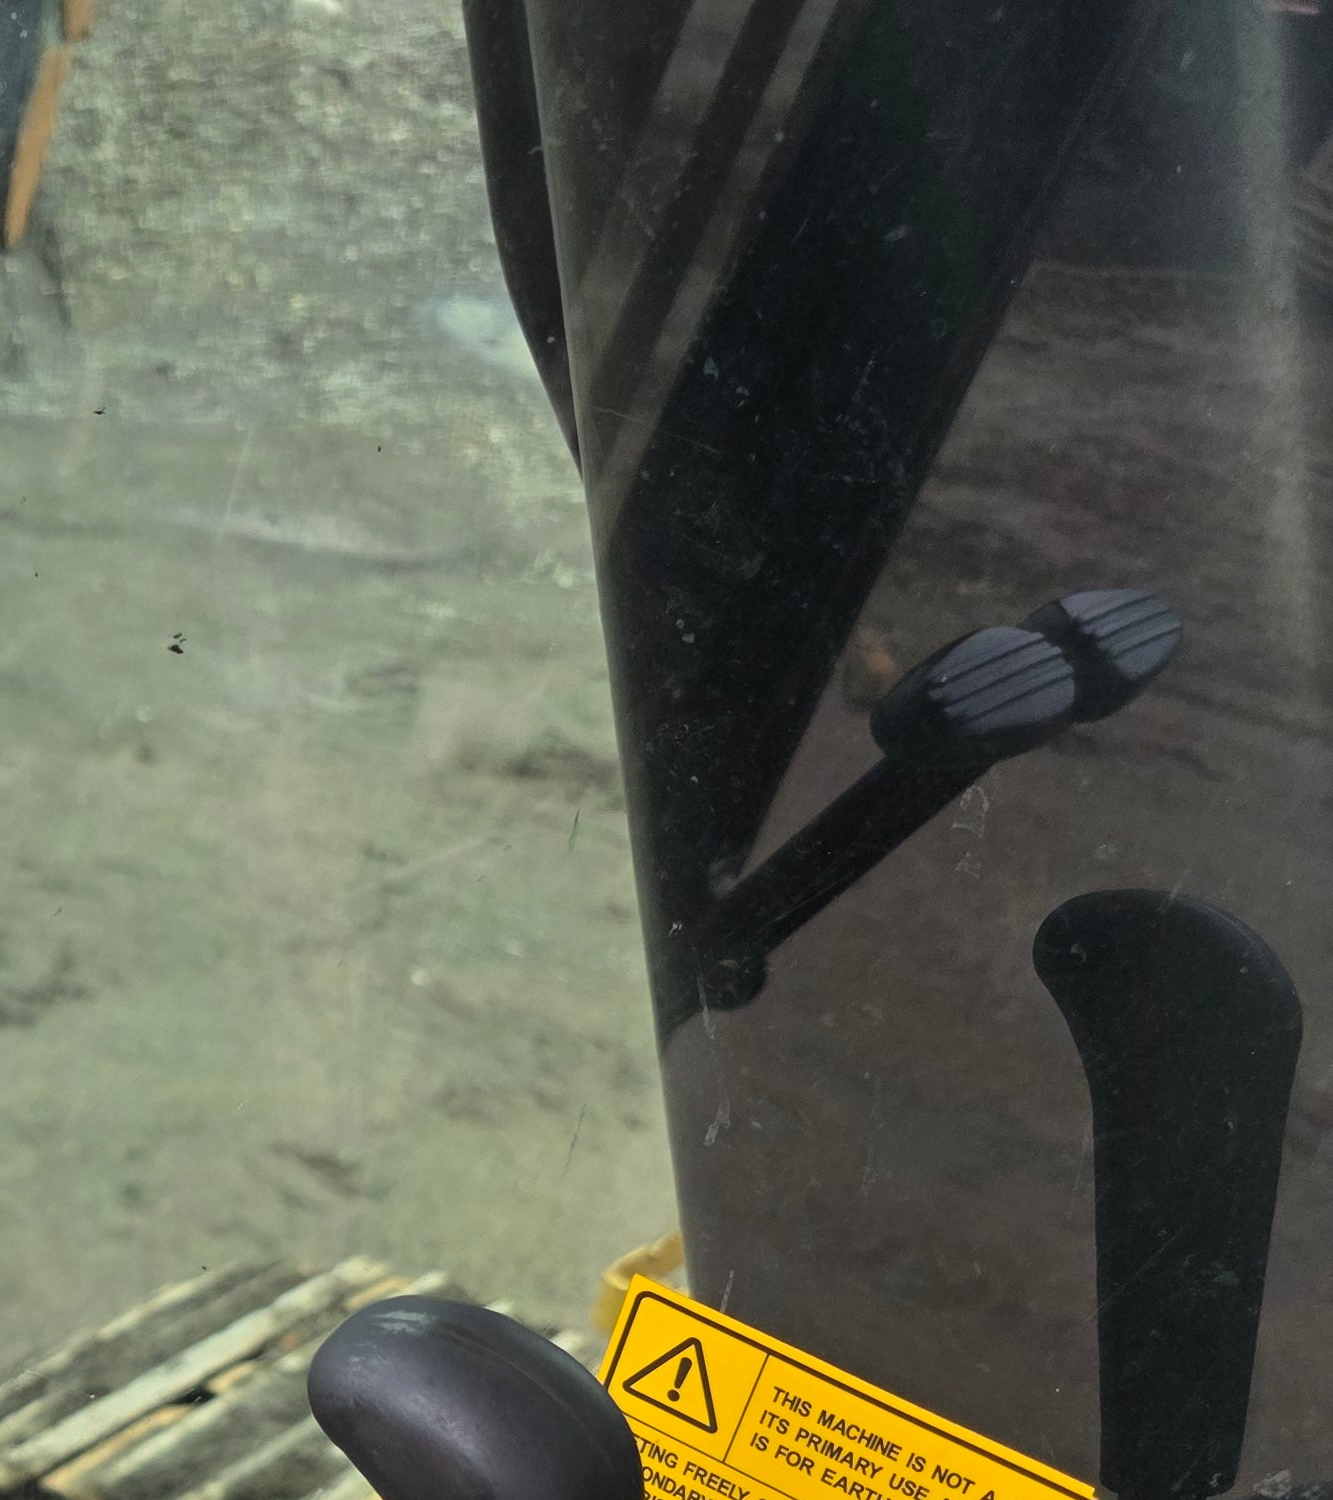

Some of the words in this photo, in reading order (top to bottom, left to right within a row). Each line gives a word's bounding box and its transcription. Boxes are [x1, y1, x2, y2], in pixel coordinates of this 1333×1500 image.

[634, 1434, 678, 1469] TING
[750, 1432, 770, 1452] IS
[774, 1444, 815, 1476] FOR
[759, 1409, 790, 1435] ITS
[795, 1427, 883, 1479] PRIMARY
[773, 1386, 813, 1418] THIS
[817, 1409, 903, 1462] MACHINE
[906, 1452, 927, 1473] IS
[931, 1464, 976, 1494] NOT
